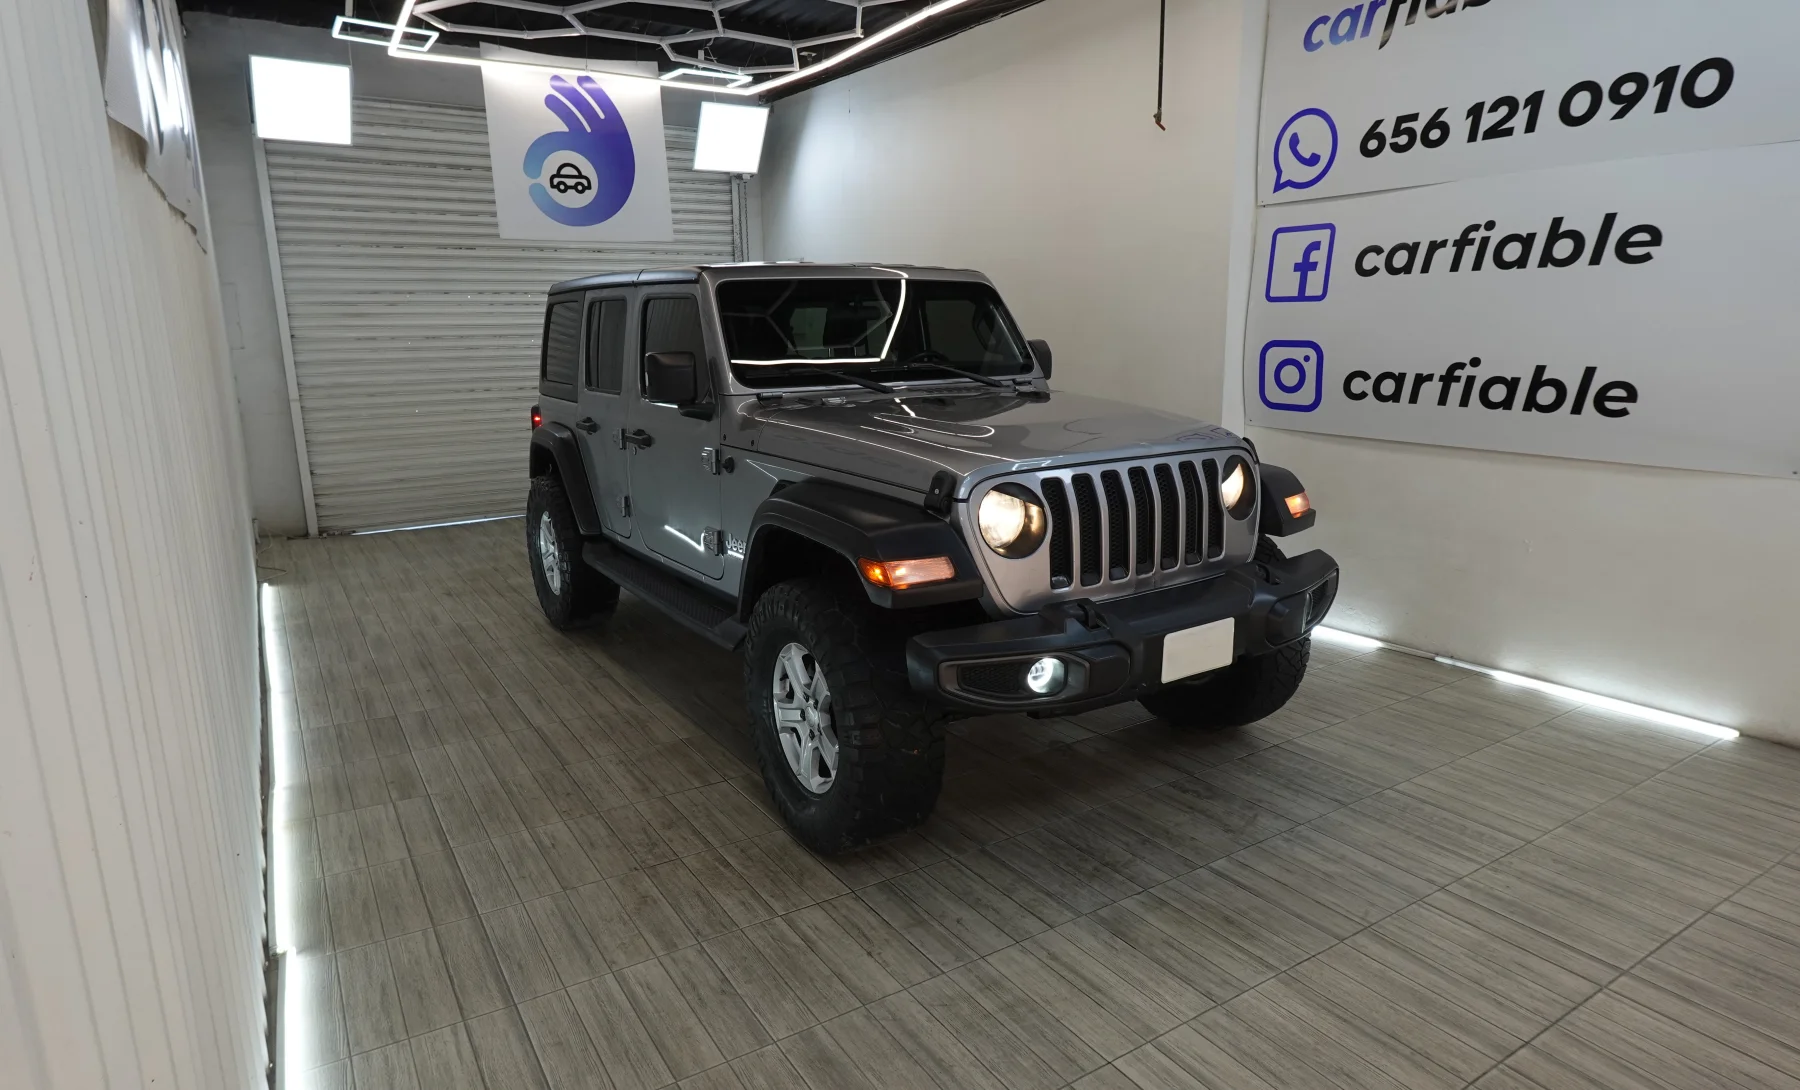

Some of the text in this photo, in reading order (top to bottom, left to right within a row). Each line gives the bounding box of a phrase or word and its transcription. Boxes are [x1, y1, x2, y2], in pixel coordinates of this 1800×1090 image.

[1359, 57, 1735, 158] 656 121 0910
[1354, 212, 1663, 278] carfiable
[1342, 357, 1639, 419] carfiable
